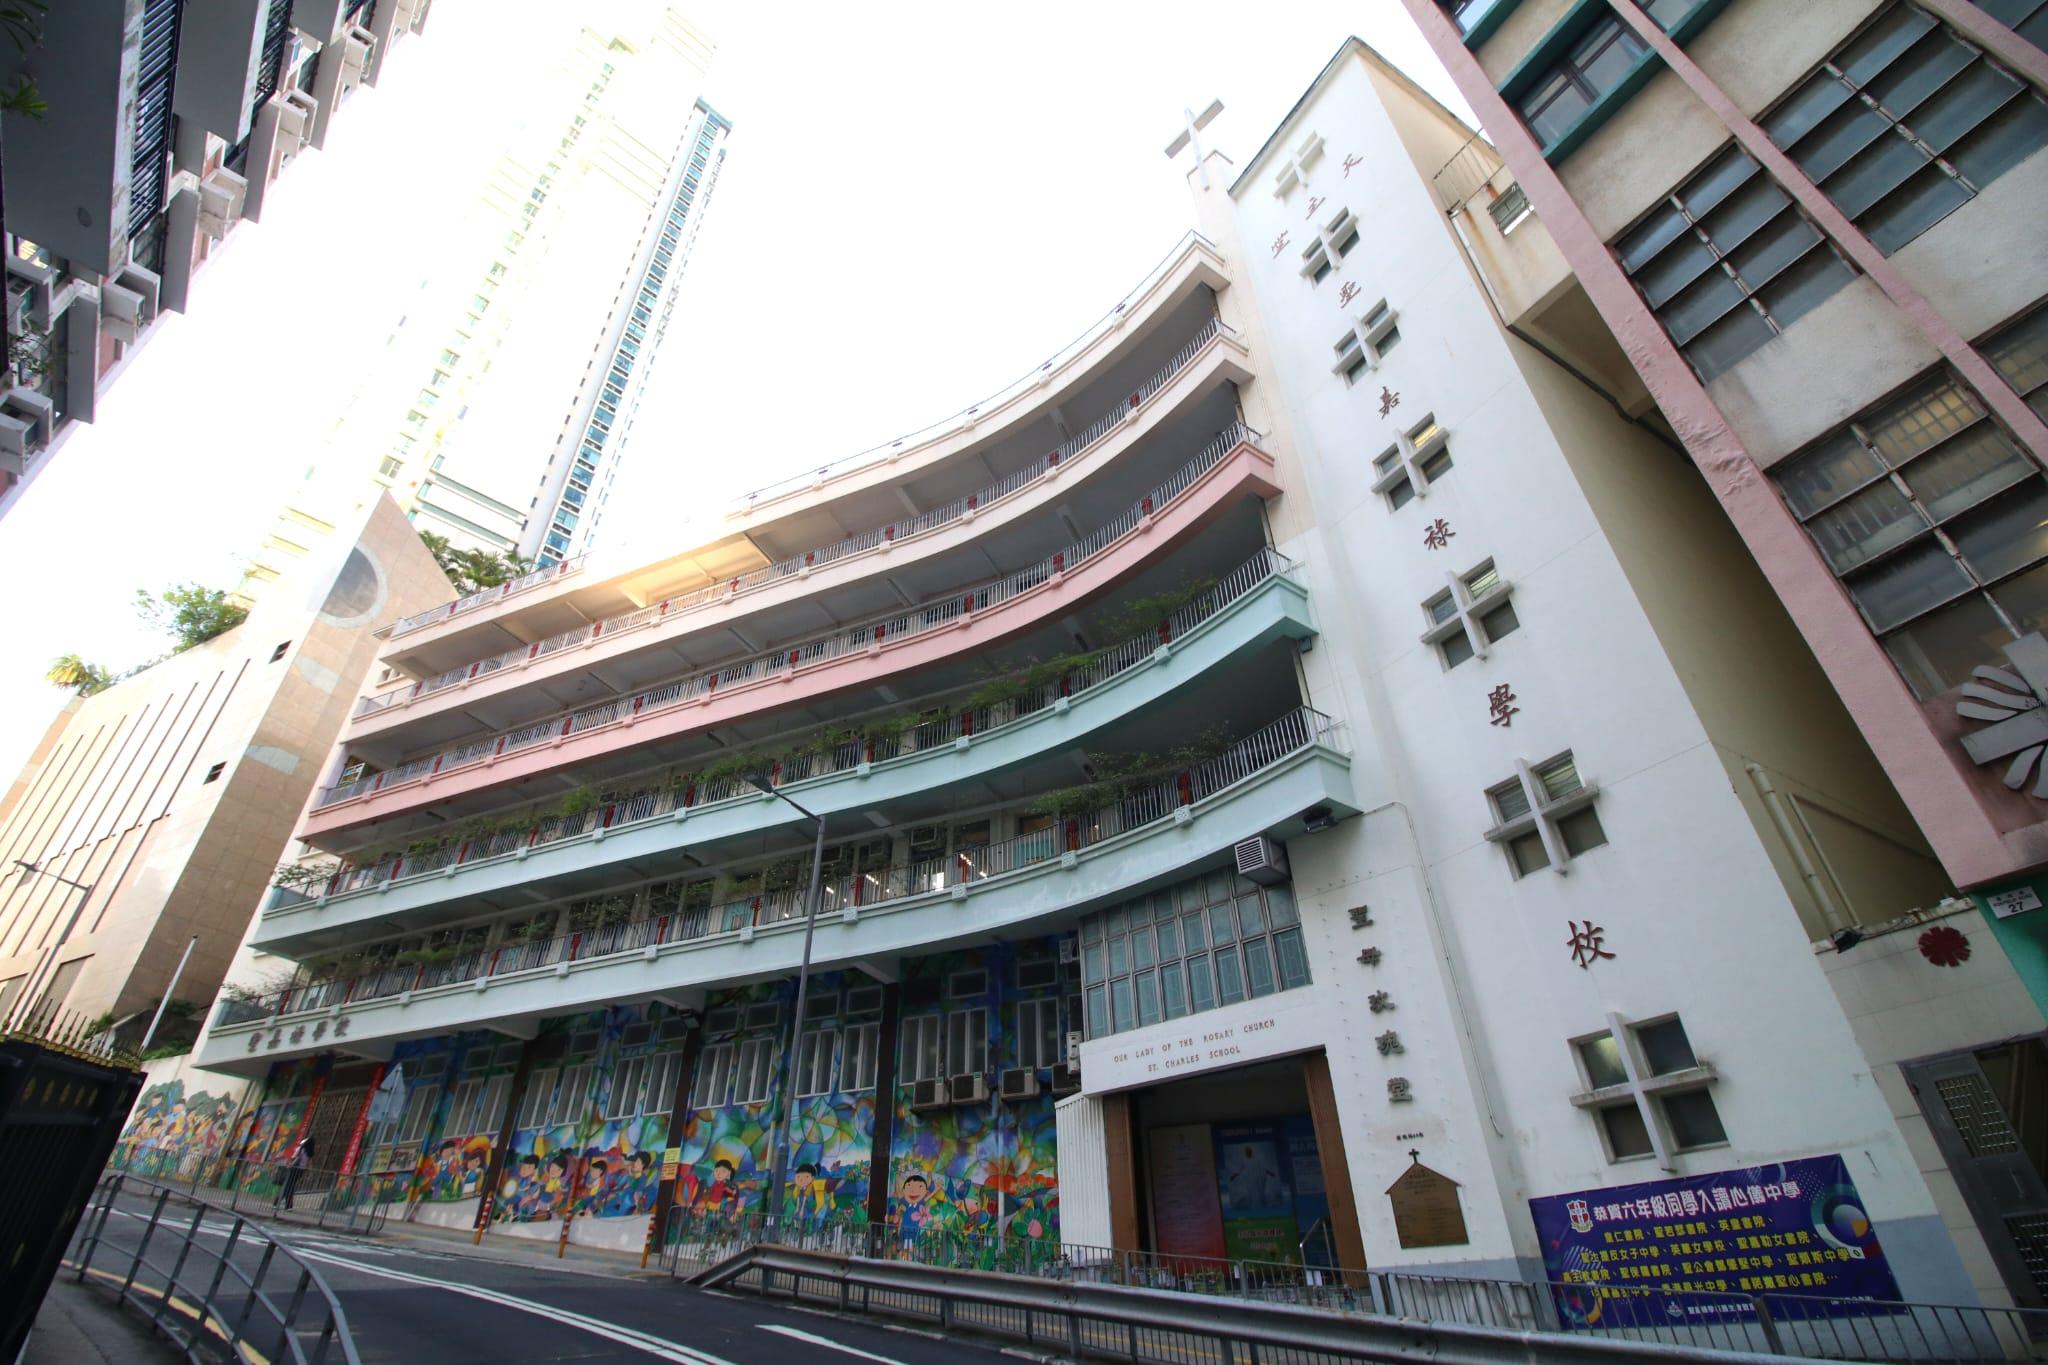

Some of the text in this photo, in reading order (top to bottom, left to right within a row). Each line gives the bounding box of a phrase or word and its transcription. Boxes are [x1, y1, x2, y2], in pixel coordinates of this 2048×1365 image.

[2008, 902, 2024, 913] 27
[1348, 905, 1413, 1104] 聖母玫瑰堂
[1113, 1019, 1275, 1063] OUR LADY OF THE ROSARY CHURCH
[1148, 1046, 1241, 1072] ST. CHARLES SCHOOL
[1593, 1181, 1801, 1222] 恭賀六年級同學入讀心儀中學
